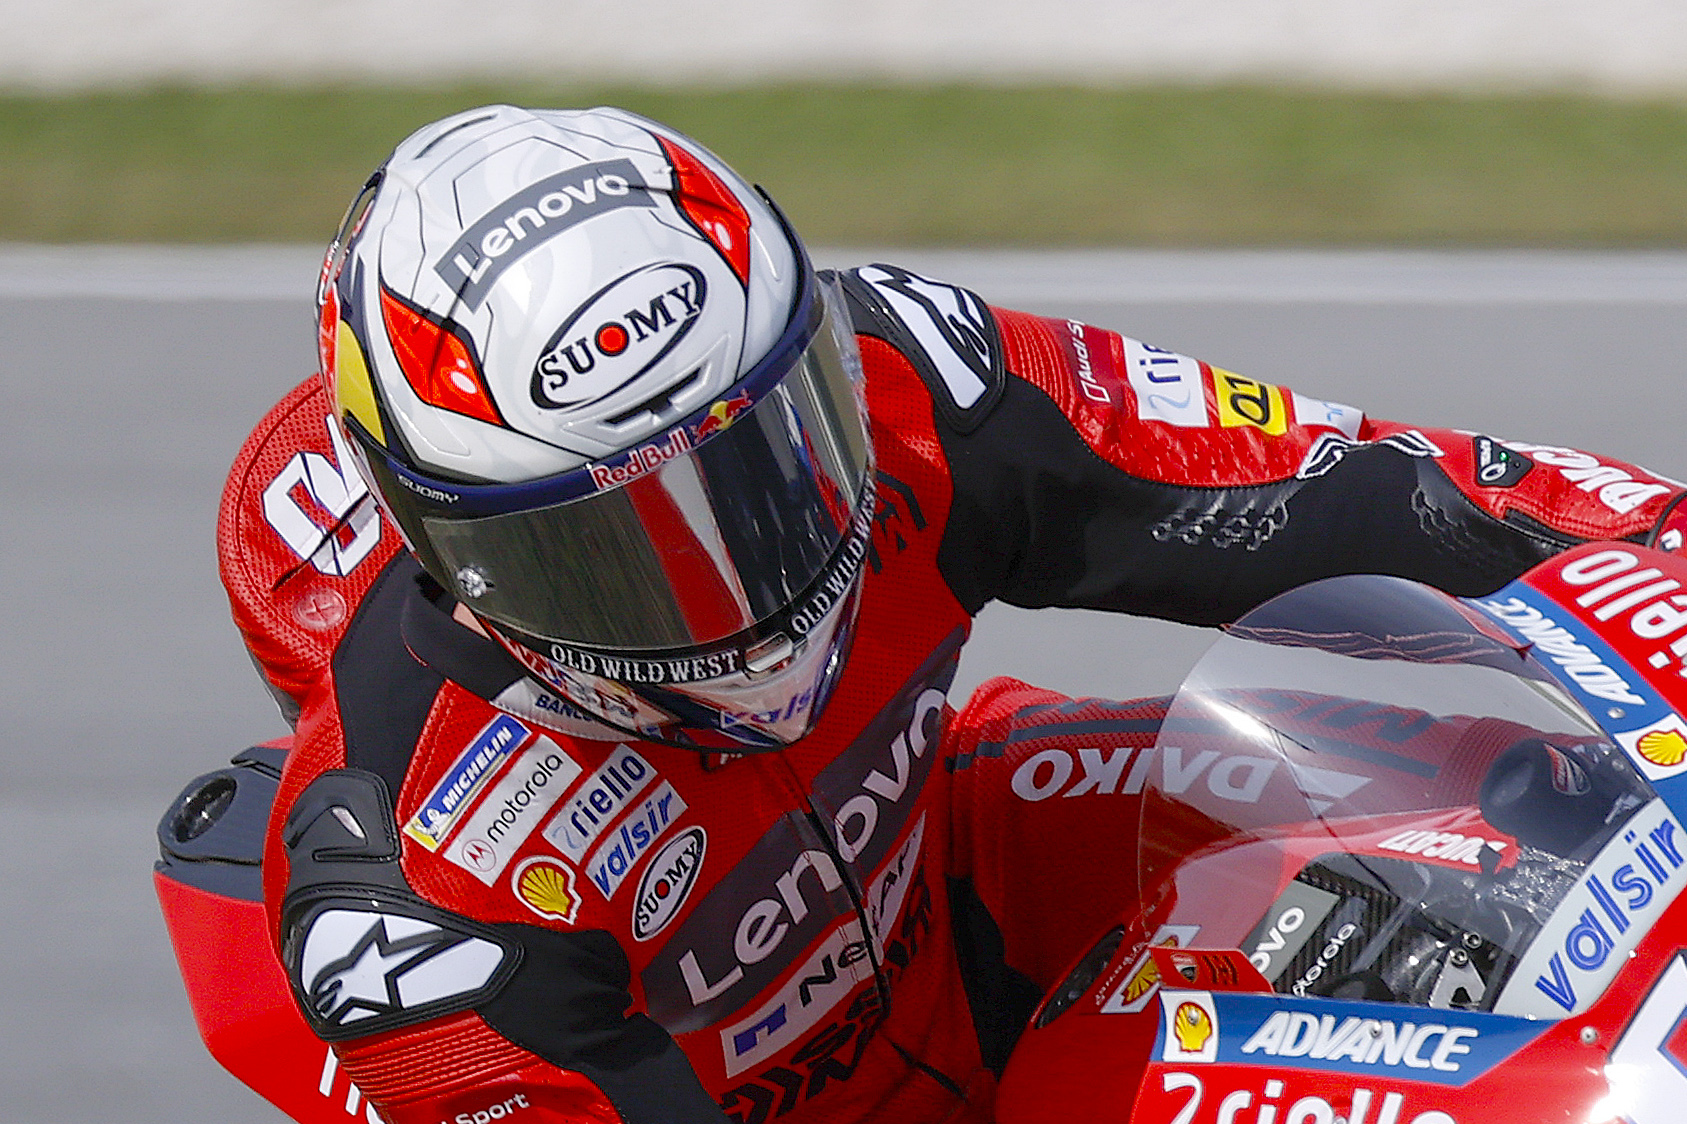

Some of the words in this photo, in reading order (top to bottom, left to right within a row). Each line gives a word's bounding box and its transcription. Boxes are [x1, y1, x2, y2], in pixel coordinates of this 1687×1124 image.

[454, 171, 630, 281] Lenovo
[539, 280, 696, 391] SUOMY
[593, 449, 642, 488] Red
[642, 428, 691, 472] Bull
[791, 593, 831, 634] OLD
[826, 538, 865, 597] WILD
[551, 643, 597, 674] OLD
[600, 657, 664, 684] WILD
[669, 651, 740, 682] WEST
[1490, 596, 1648, 708] ADVANCE
[443, 726, 512, 812] MICHELIN
[487, 752, 564, 844] motorola
[571, 755, 646, 840] riello
[1012, 746, 1278, 803] DAIKO
[595, 790, 675, 899] valsir
[636, 840, 703, 928] SUOMY
[675, 687, 948, 1006] Lenovo
[1535, 818, 1687, 1013] valsir
[1242, 1010, 1479, 1072] ADVANCE
